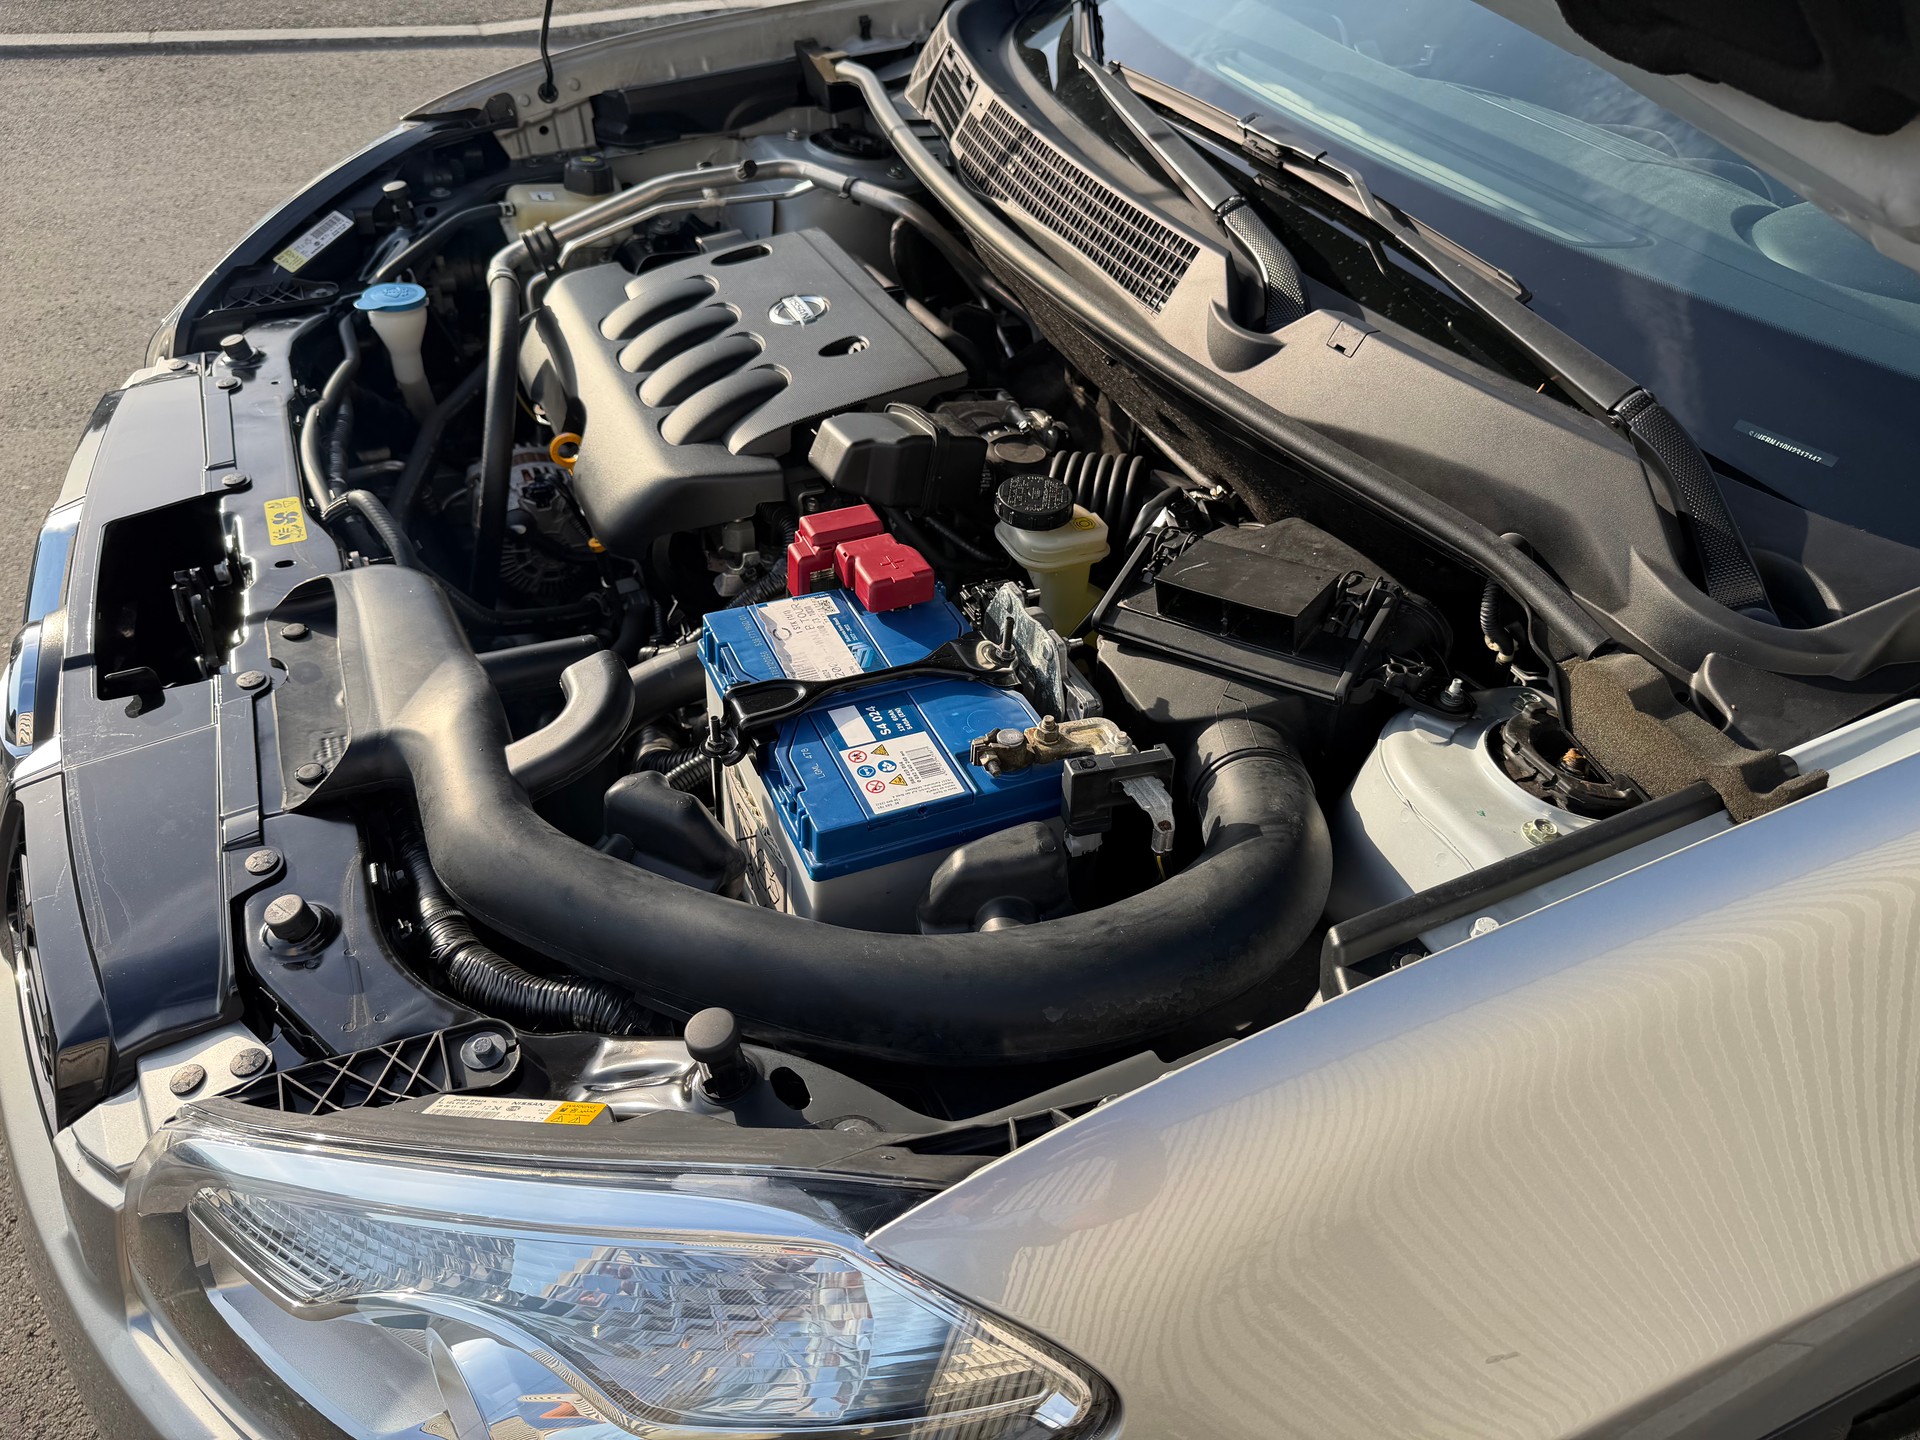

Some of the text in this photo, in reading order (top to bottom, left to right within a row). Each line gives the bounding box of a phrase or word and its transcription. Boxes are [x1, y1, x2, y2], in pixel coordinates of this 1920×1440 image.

[790, 602, 809, 623] TOUR
[863, 704, 893, 736] S4 024
[894, 722, 906, 732] 12V
